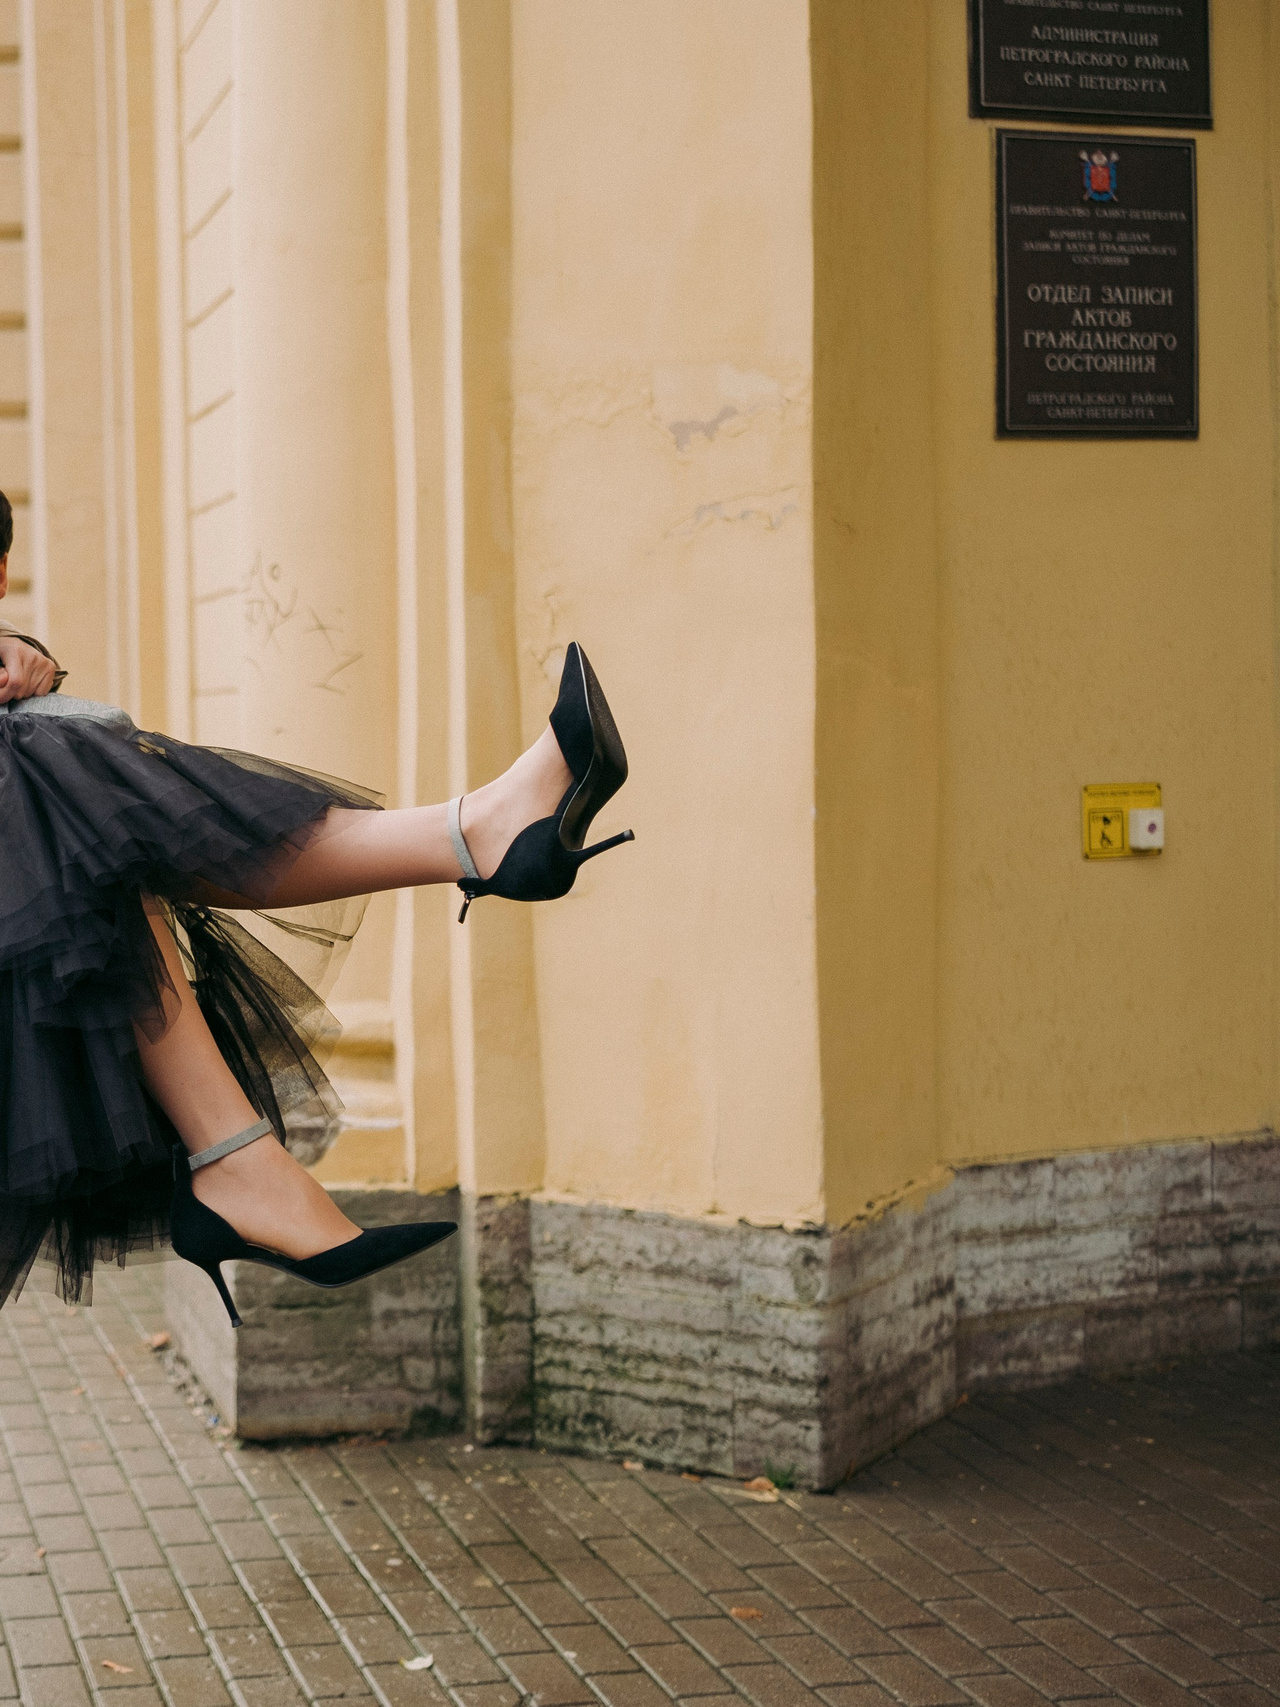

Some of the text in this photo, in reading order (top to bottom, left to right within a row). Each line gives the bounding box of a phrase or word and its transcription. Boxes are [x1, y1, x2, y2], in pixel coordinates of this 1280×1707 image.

[1031, 25, 1158, 47] АДМИНИСТРАЦИЯ
[1000, 46, 1190, 71] ПЕТРОГРАДСКОГО РАЙОНА
[1027, 284, 1173, 306] ОТДЕЛ ЗАПИСИ
[1071, 309, 1132, 328] АКТОВ
[1024, 331, 1178, 351] ГРАЖДАНСКОГО
[1045, 354, 1157, 373] СОСТОЯНИЯ
[1131, 393, 1174, 406] РАЙОНА
